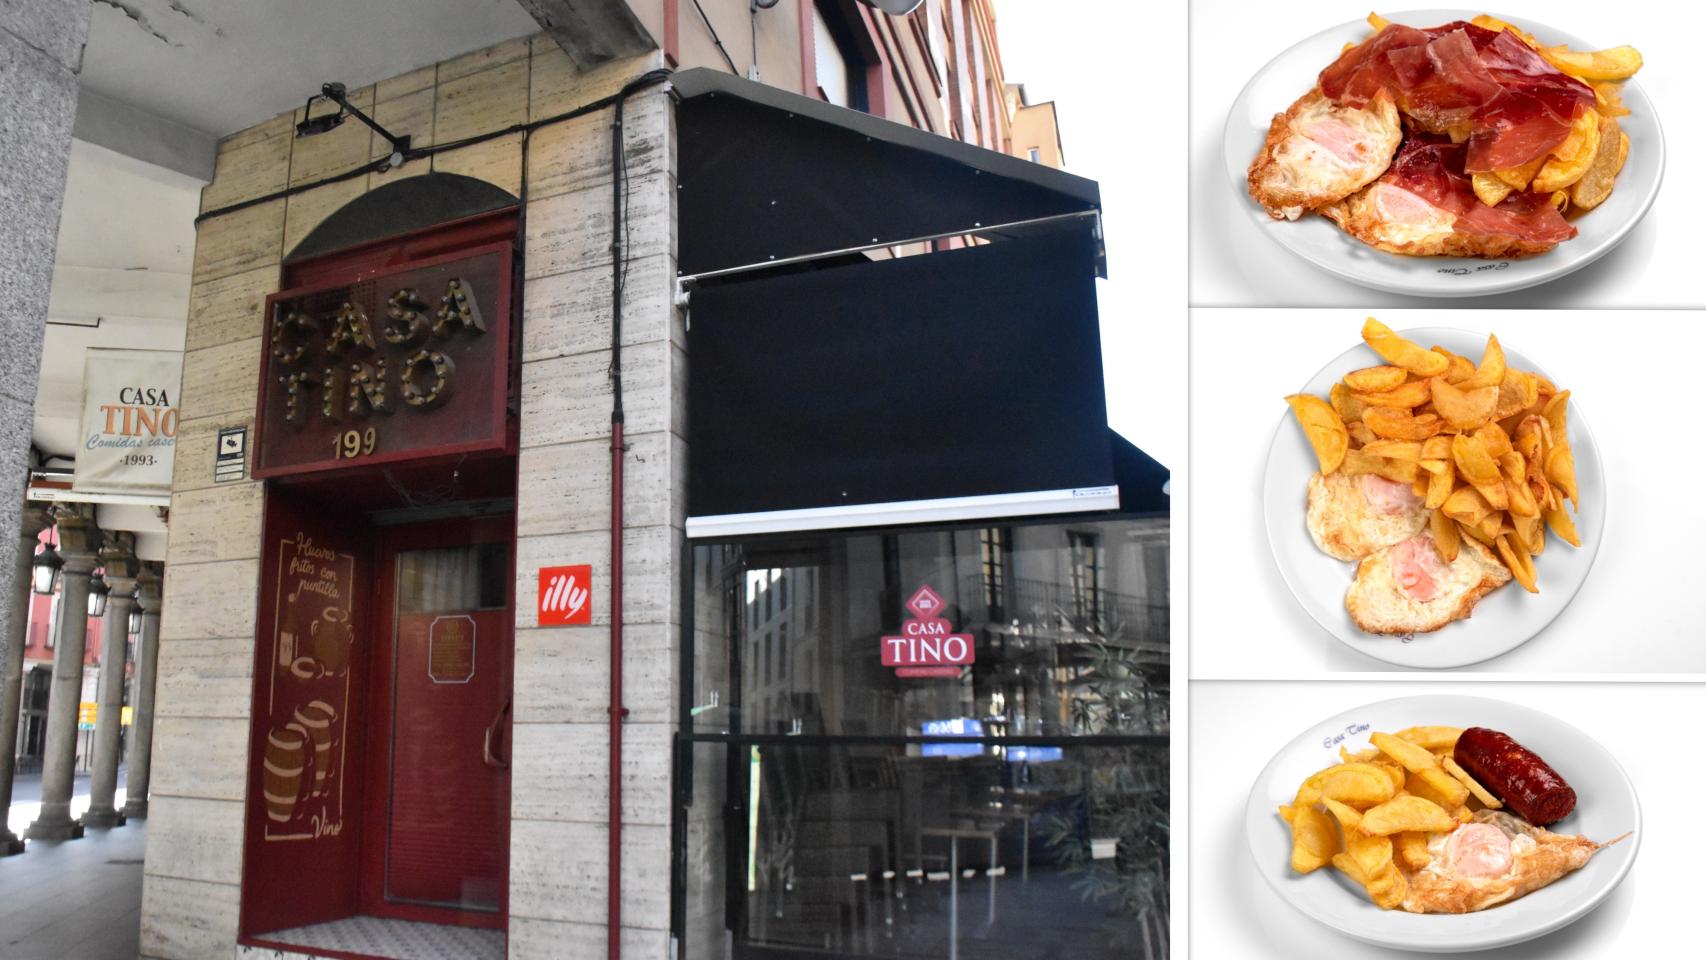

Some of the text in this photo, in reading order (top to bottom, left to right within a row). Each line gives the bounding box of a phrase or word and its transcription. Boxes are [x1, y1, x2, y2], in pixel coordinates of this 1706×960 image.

[272, 277, 487, 364] CASA
[119, 386, 169, 407] CASA
[277, 349, 456, 424] TINO
[100, 405, 178, 438] TINO
[86, 433, 177, 450] Comidas case
[289, 556, 337, 581] fritos con
[542, 574, 588, 620] illy
[907, 622, 945, 635] CASA
[887, 636, 968, 662] TINO
[311, 805, 343, 839] Vino
